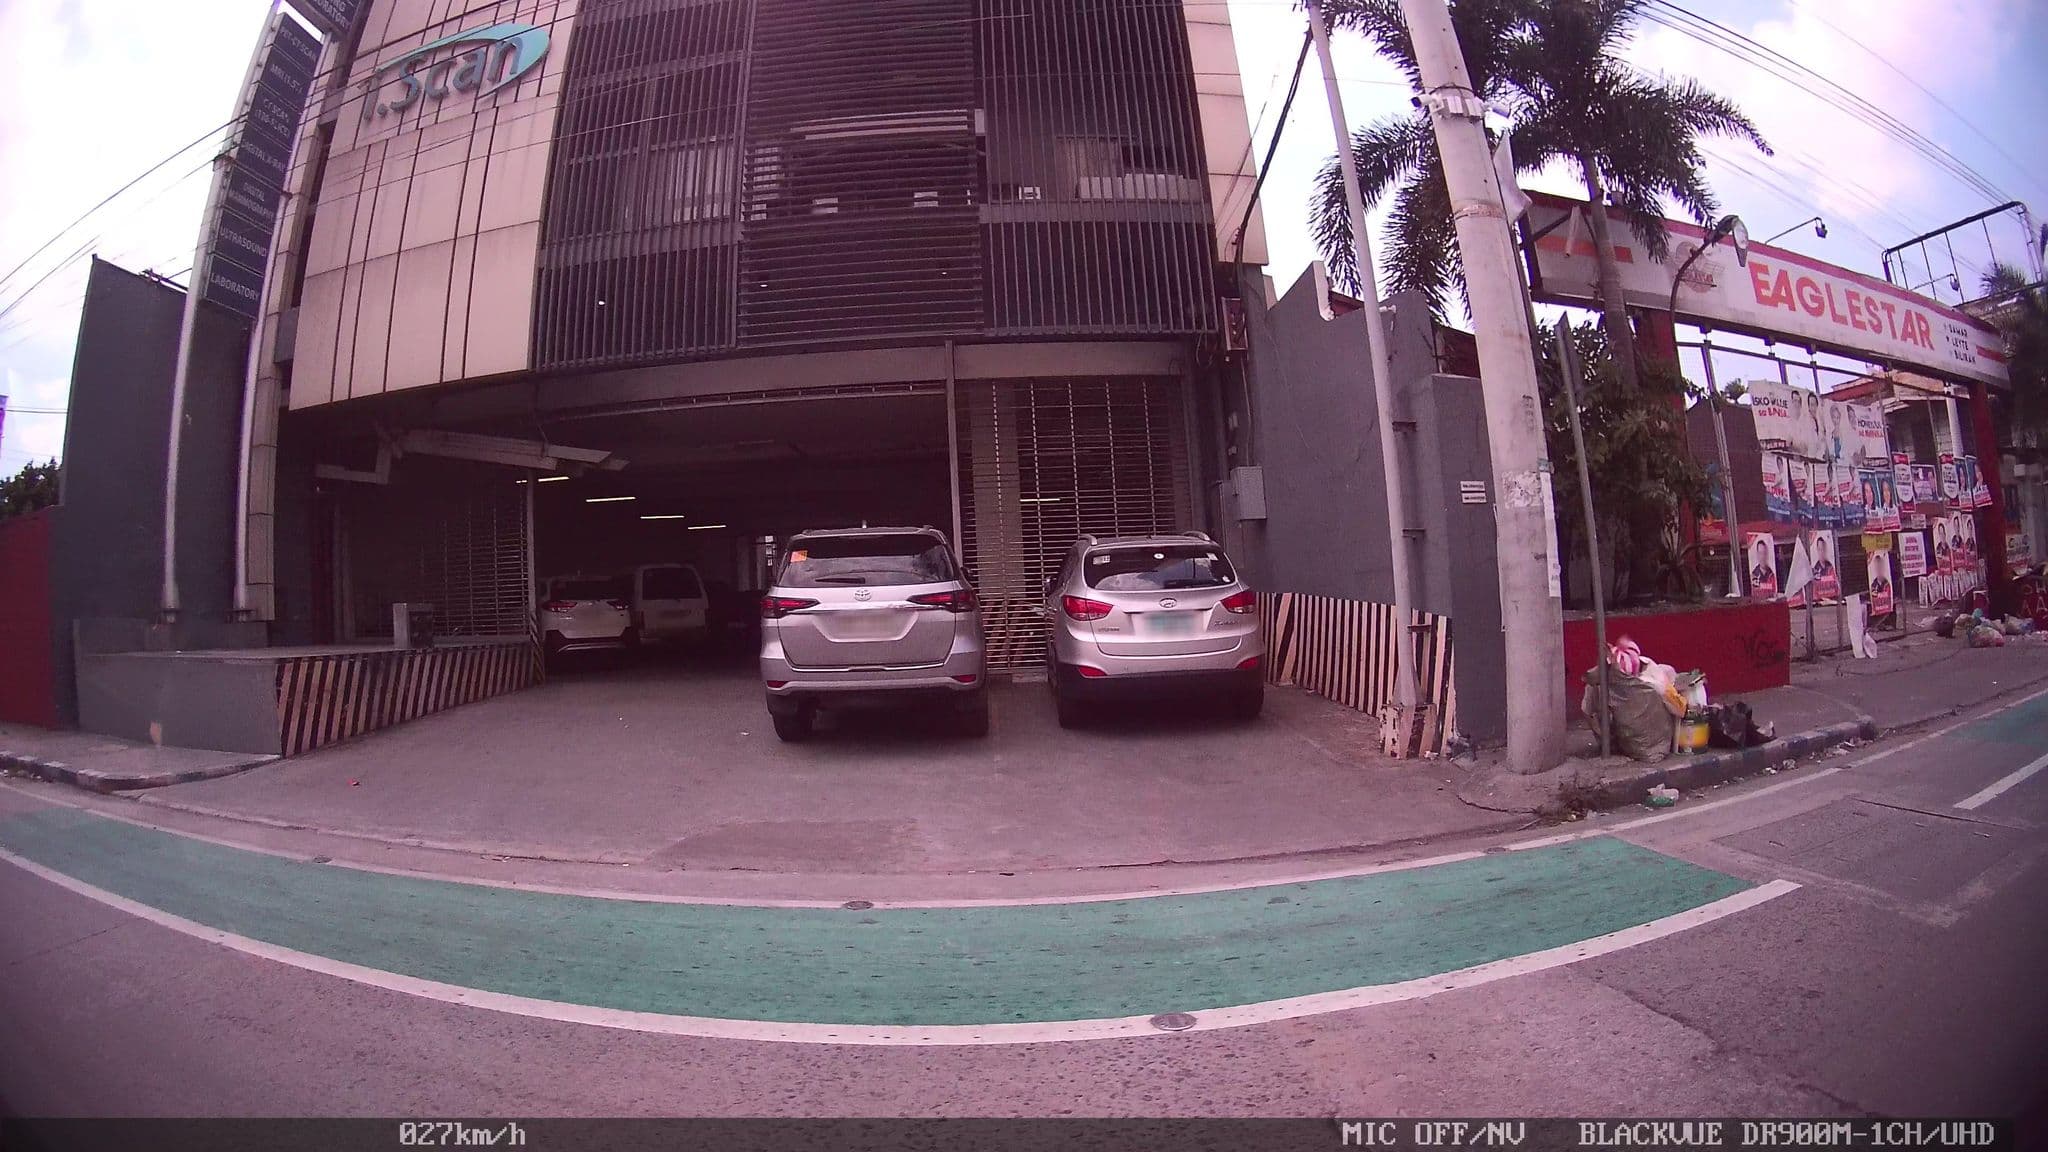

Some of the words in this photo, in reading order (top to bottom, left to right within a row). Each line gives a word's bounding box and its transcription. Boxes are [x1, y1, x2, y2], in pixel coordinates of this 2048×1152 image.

[220, 227, 268, 257] ULTRASOUND
[210, 272, 260, 300] LABORATORY
[1748, 261, 1935, 351] EAGLESTAR
